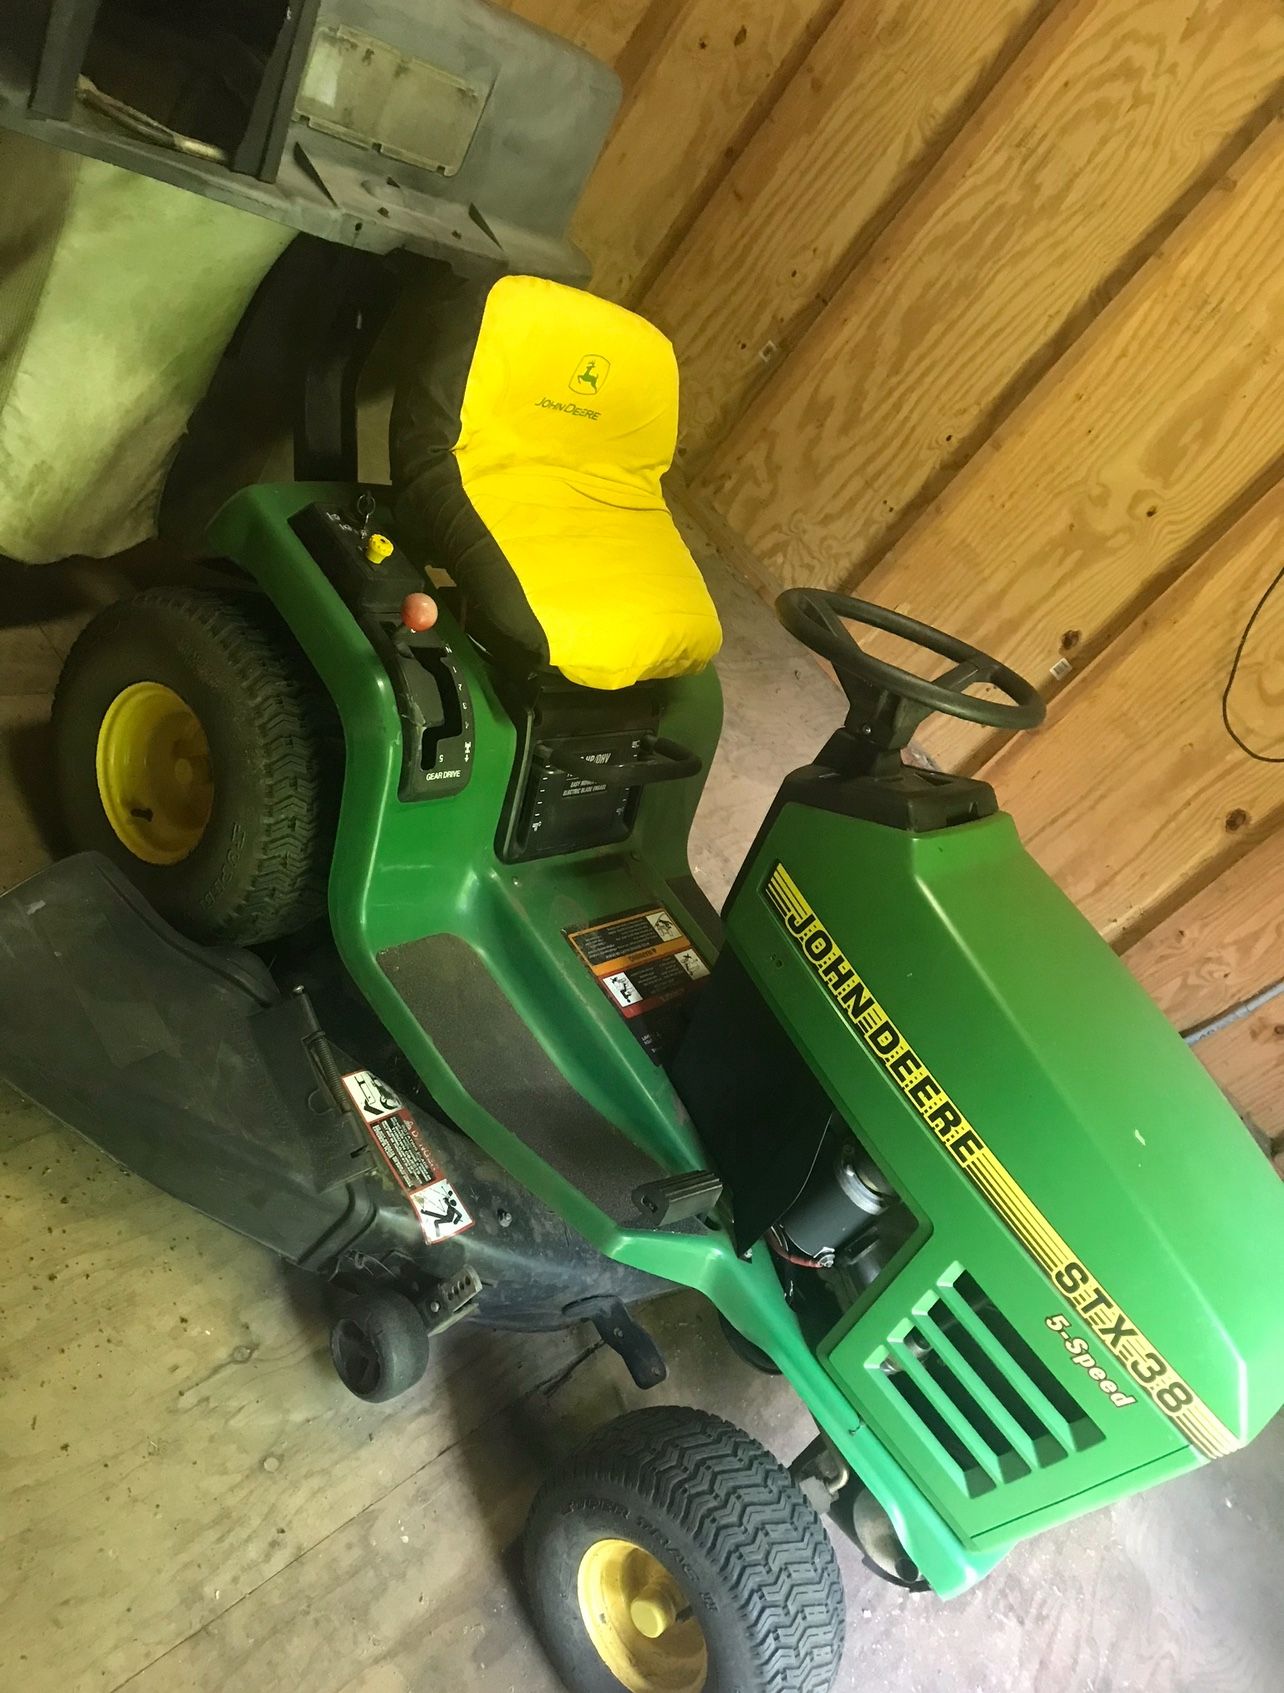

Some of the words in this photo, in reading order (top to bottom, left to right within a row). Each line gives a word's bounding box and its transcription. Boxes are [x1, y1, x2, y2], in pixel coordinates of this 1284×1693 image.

[425, 771, 444, 781] GEAR
[442, 769, 462, 779] DRIVE
[786, 914, 876, 1021] JOHN
[867, 1020, 985, 1164] DEERE
[1044, 1313, 1138, 1408] 5-Speed
